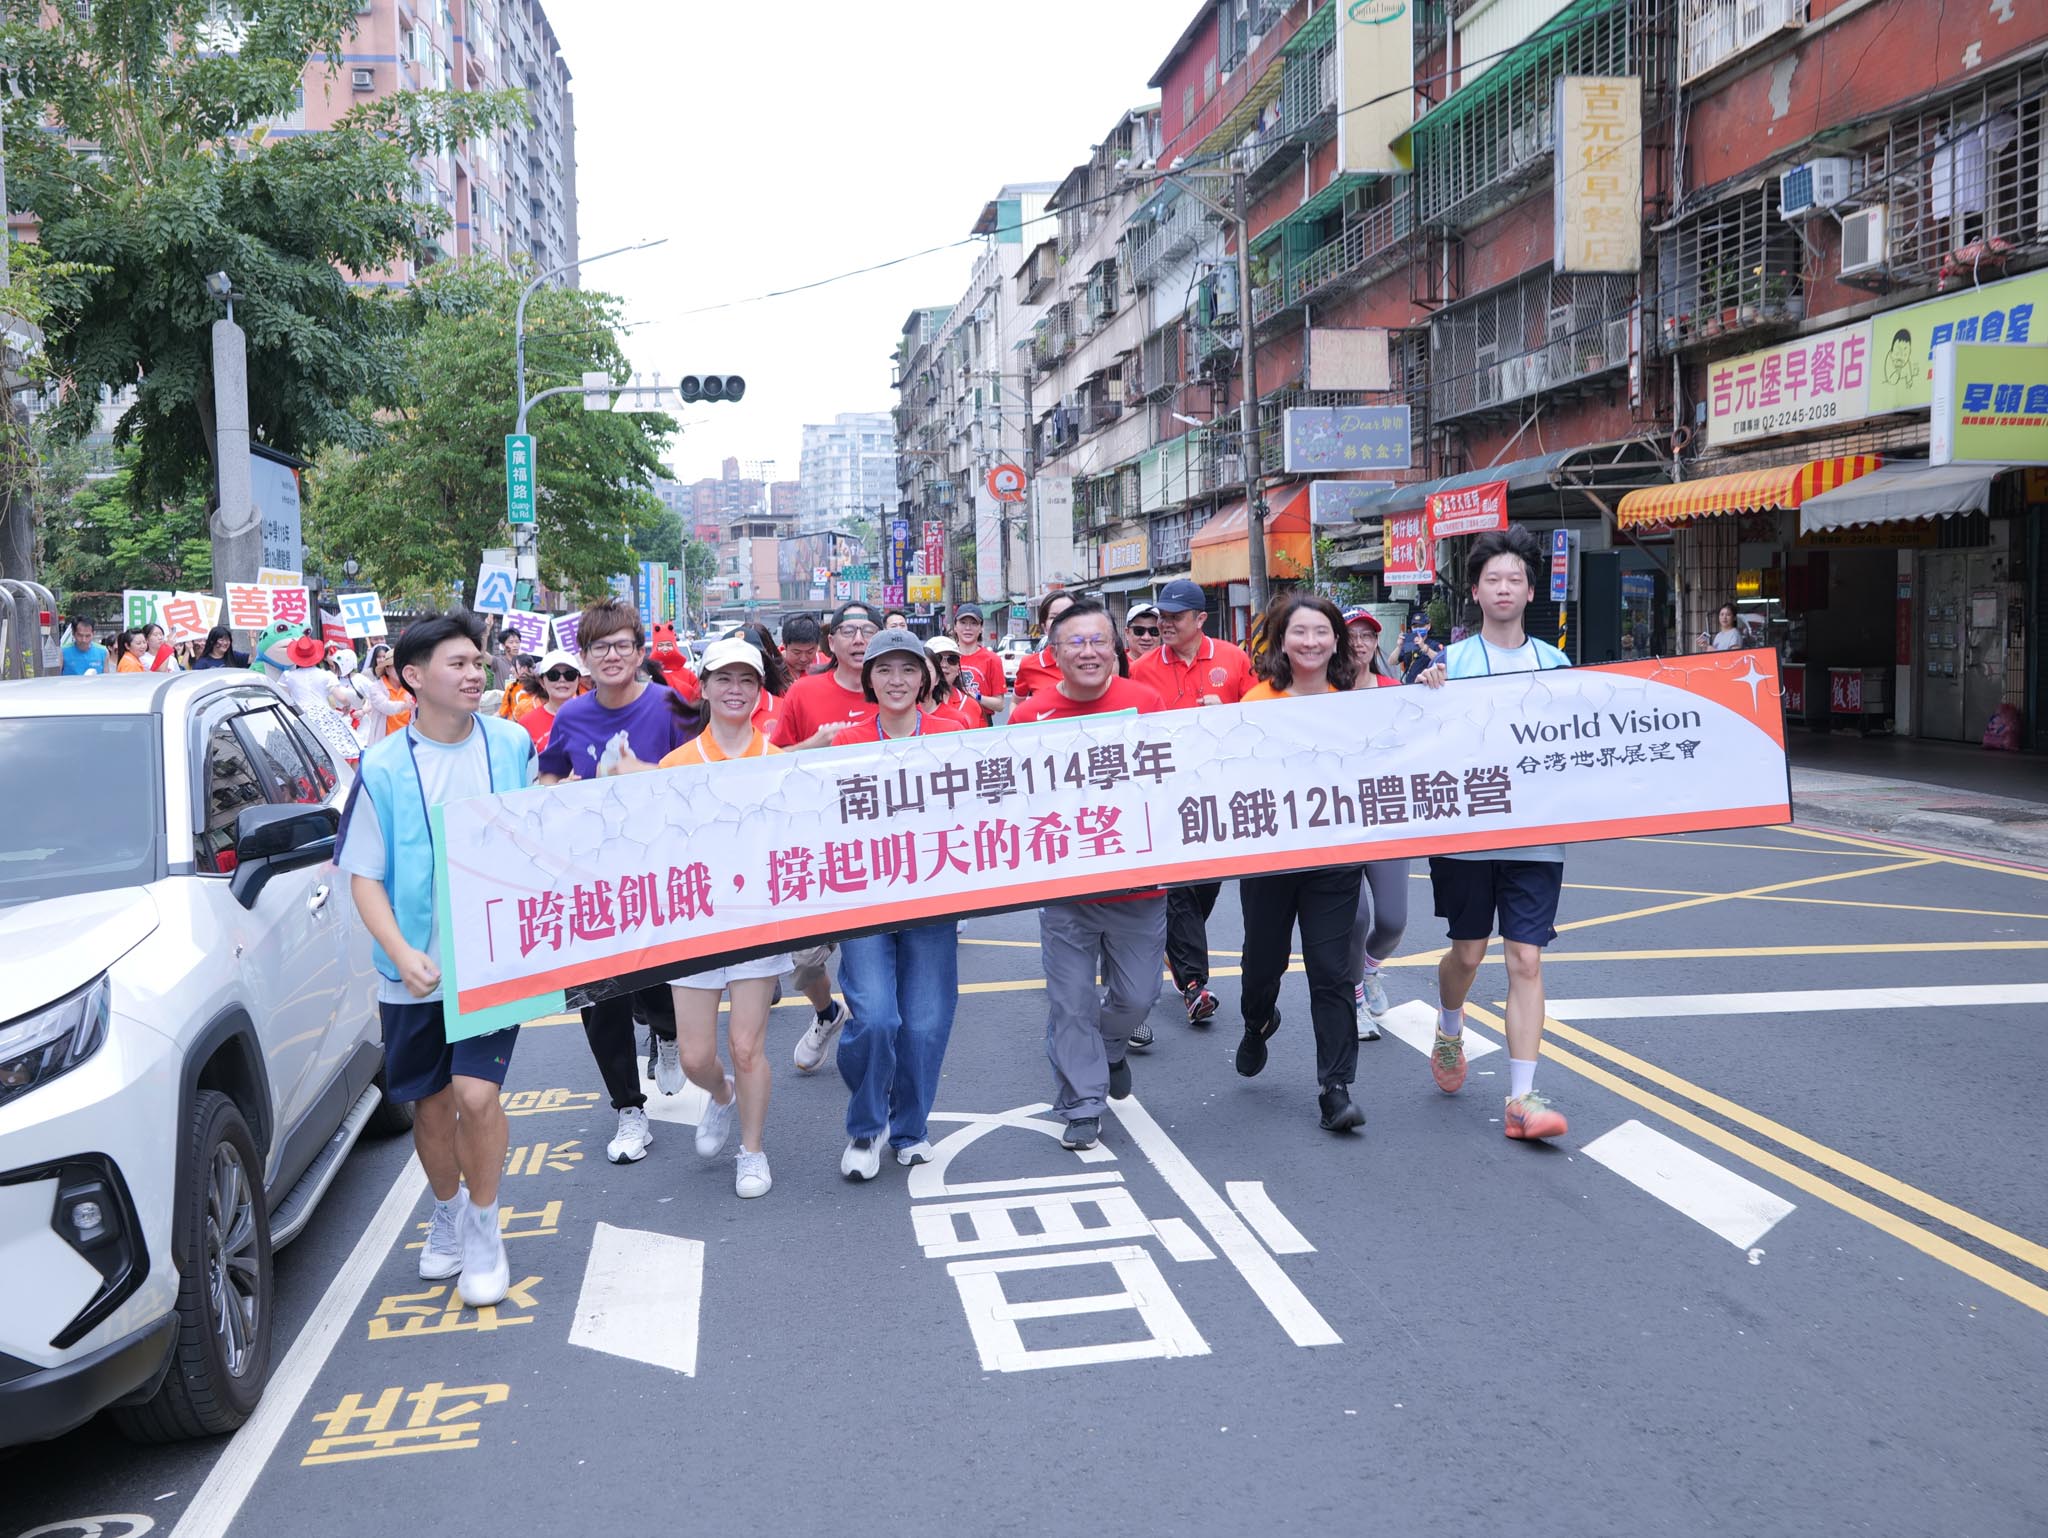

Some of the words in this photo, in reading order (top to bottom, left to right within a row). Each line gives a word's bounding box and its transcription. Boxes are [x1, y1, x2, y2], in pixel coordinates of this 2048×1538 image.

[1712, 333, 1866, 417] 吉元堡早餐店
[1762, 402, 1838, 431] 02-2245-2038
[512, 450, 528, 499] 廣福路
[229, 586, 270, 627] 善
[272, 588, 307, 624] 愛
[479, 572, 513, 612] 公
[162, 598, 208, 637] 良
[341, 596, 381, 634] 平
[507, 613, 547, 653] 尊
[1510, 711, 1601, 745] World
[1608, 707, 1701, 735] Vision
[836, 738, 1176, 825] 南山中學114學年
[1177, 765, 1513, 846] 飢餓12h體驗營
